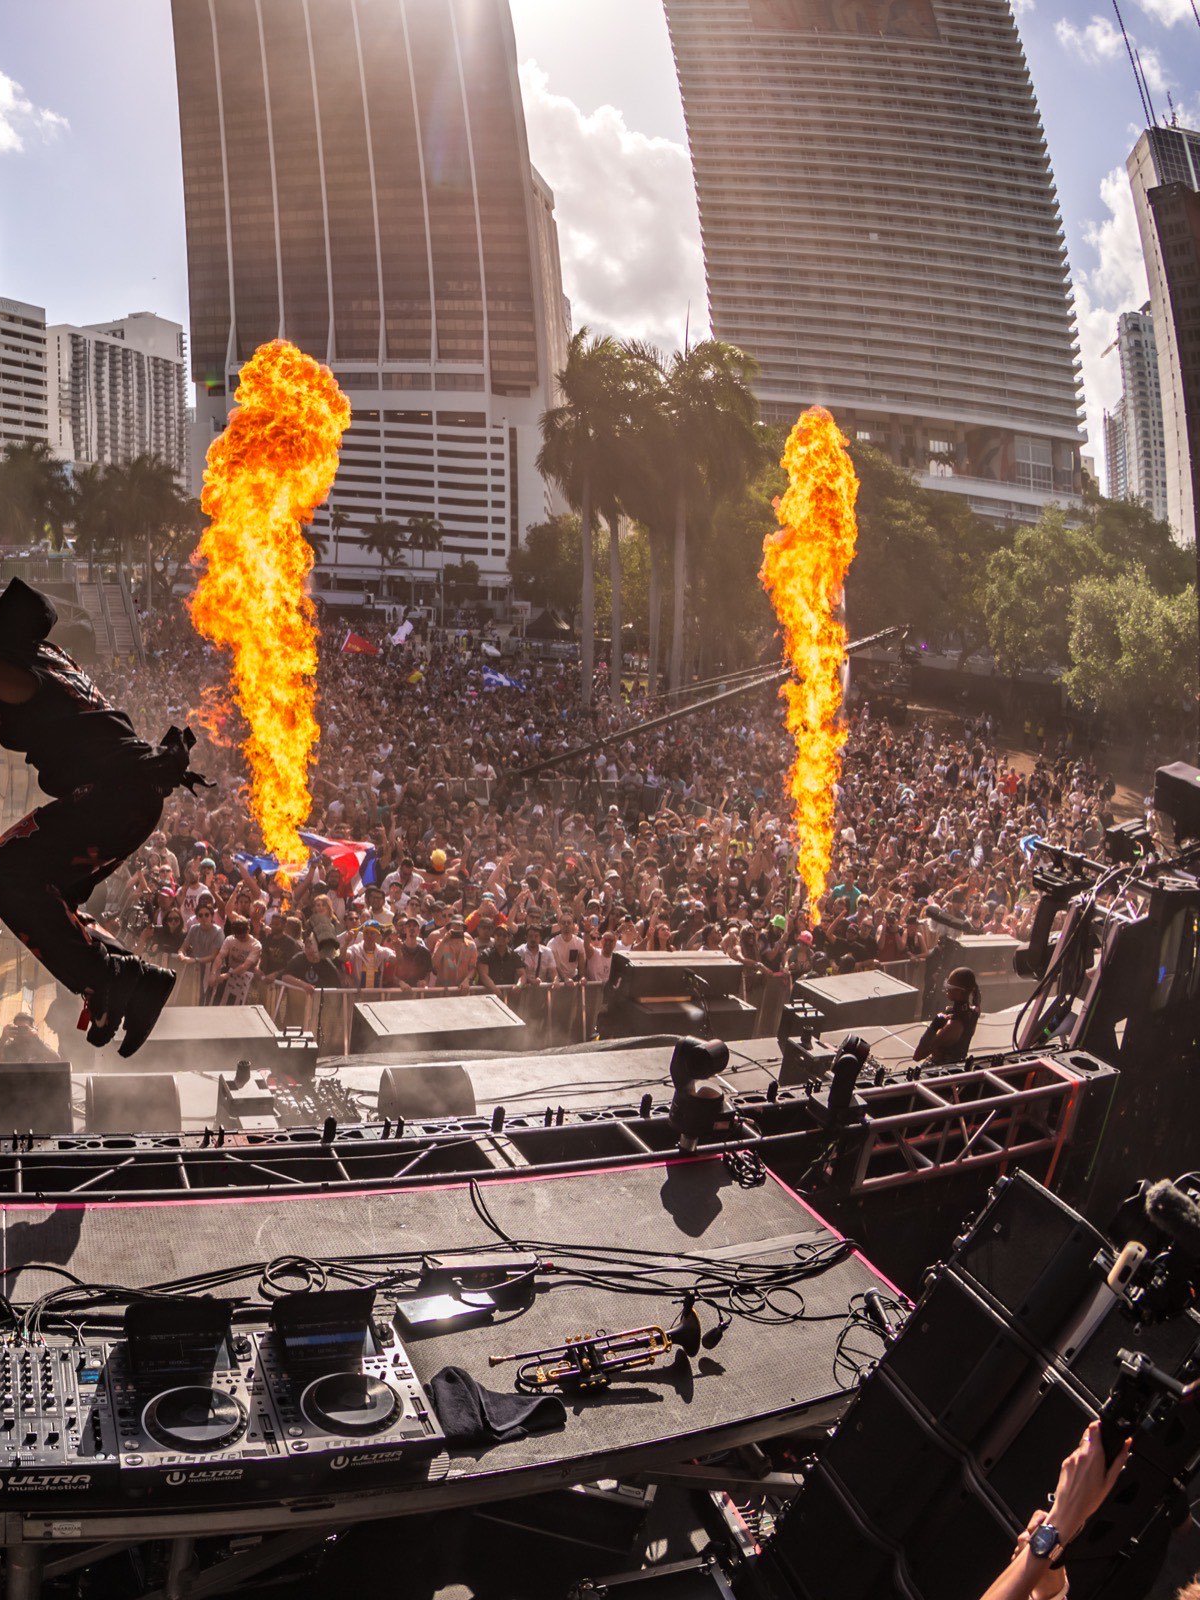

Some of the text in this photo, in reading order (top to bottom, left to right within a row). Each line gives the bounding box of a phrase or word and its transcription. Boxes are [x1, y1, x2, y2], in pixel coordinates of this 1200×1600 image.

[159, 1451, 242, 1466] ULTRA
[349, 1450, 403, 1462] ULTRA
[188, 1468, 244, 1479] ULTRA
[8, 1474, 91, 1486] ULTRA
[7, 1483, 90, 1492] musicfestival
